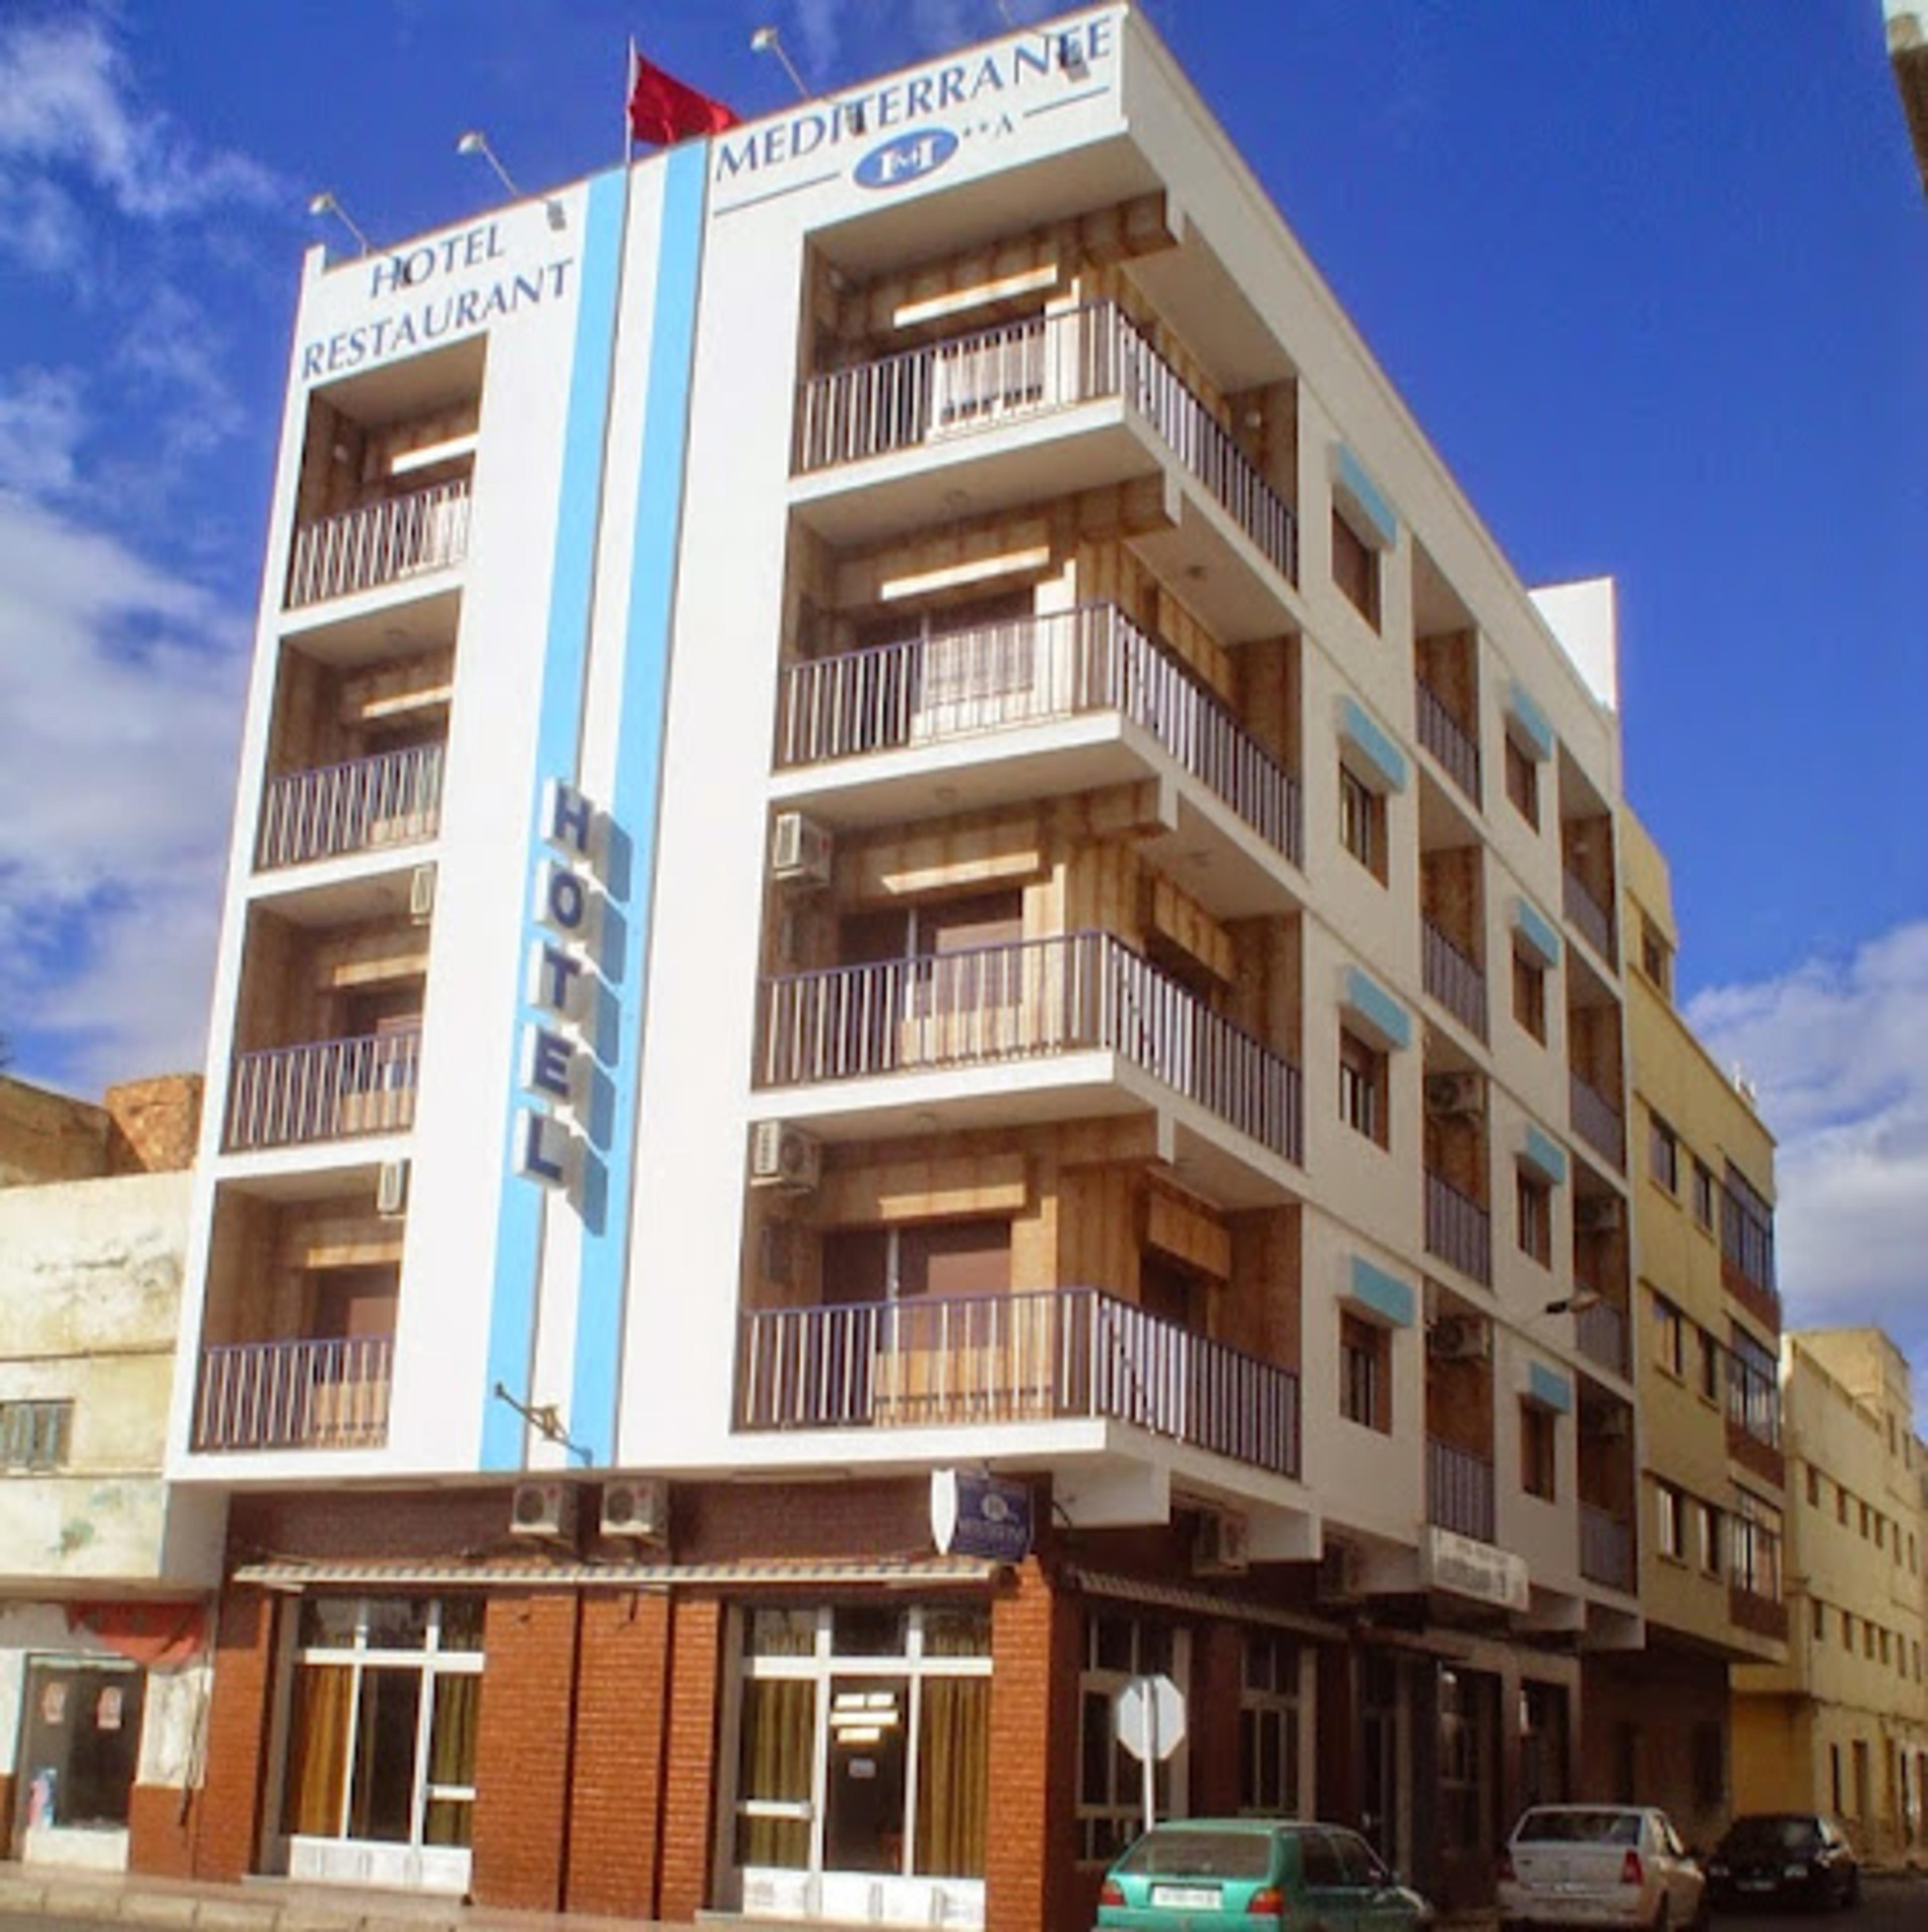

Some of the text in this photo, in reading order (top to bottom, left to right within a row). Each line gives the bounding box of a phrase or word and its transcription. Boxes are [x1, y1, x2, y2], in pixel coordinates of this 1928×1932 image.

[302, 258, 574, 380] RESTAURANT
[371, 224, 505, 298] HOTEL
[525, 781, 590, 1182] HOTEL
